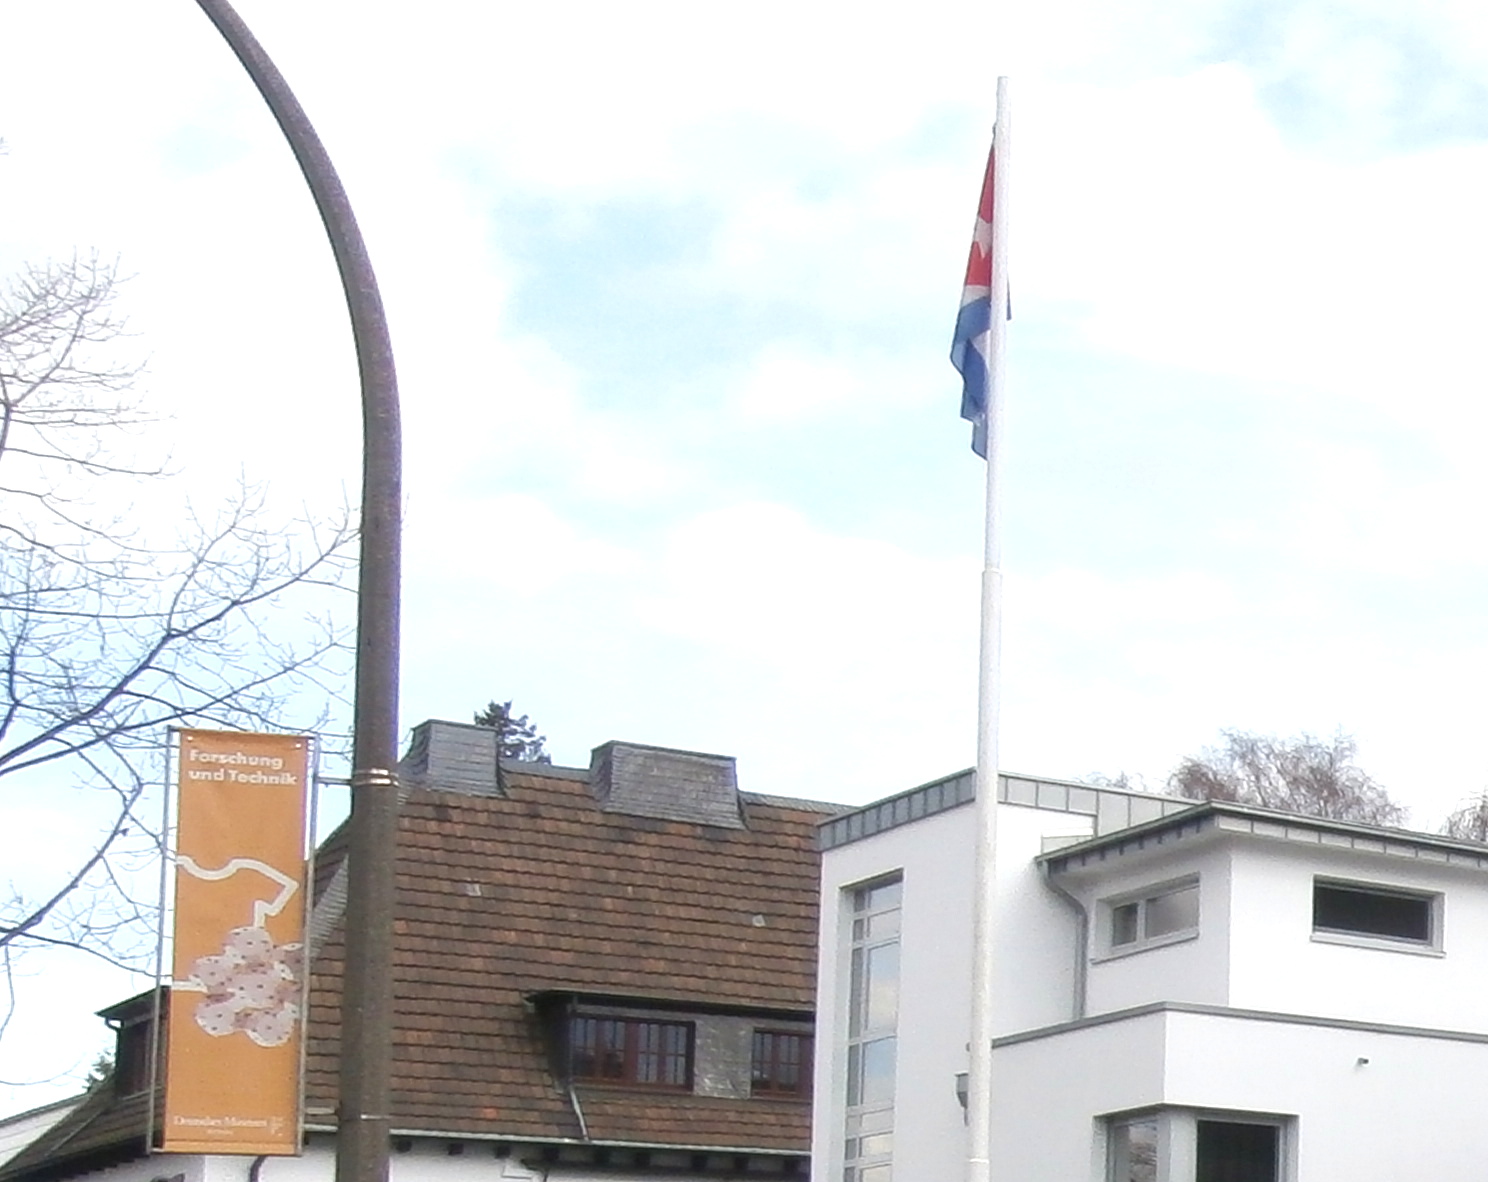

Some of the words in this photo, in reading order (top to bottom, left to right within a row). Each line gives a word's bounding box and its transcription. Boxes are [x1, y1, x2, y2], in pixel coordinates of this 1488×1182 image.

[189, 749, 284, 770] Forschung
[188, 768, 225, 781] und
[228, 769, 298, 785] Technik
